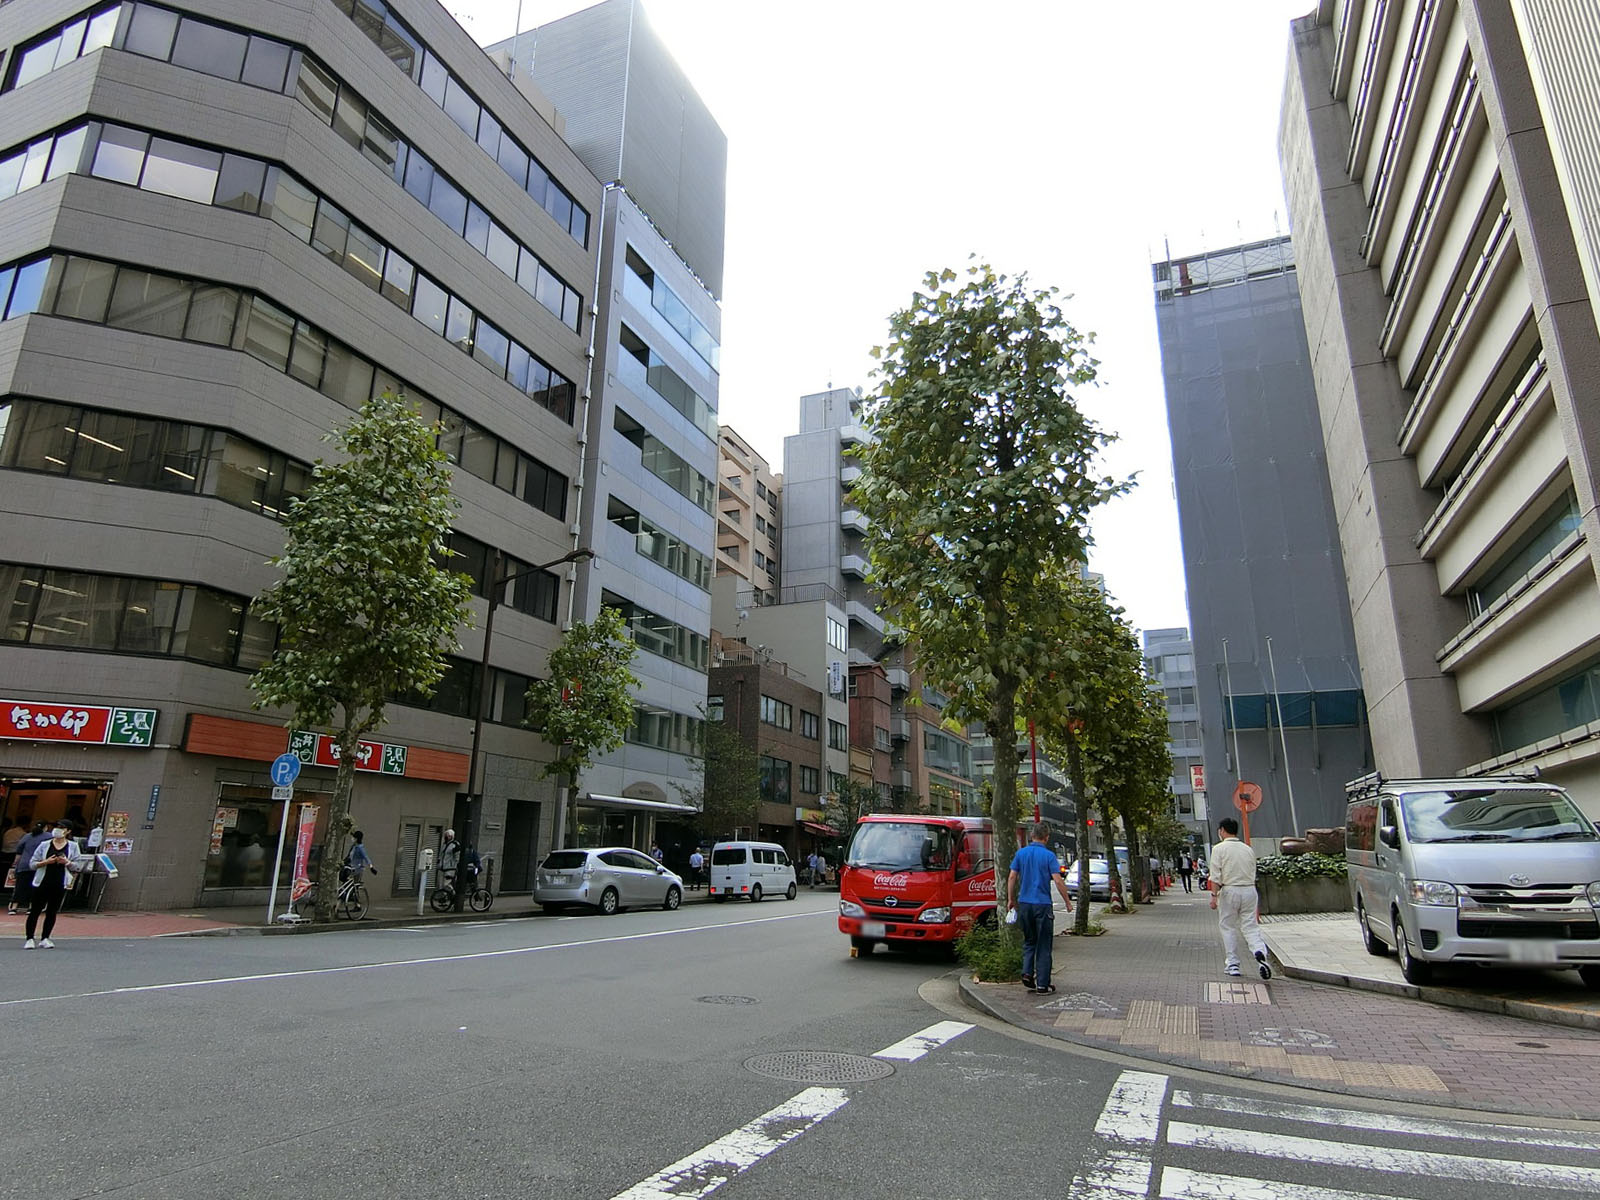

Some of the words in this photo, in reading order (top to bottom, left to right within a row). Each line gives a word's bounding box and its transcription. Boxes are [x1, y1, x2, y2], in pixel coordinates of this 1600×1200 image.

[11, 706, 89, 737] なか卯
[116, 711, 144, 744] うどん
[330, 743, 373, 766] な卯
[386, 746, 402, 773] うどん
[277, 762, 290, 783] P
